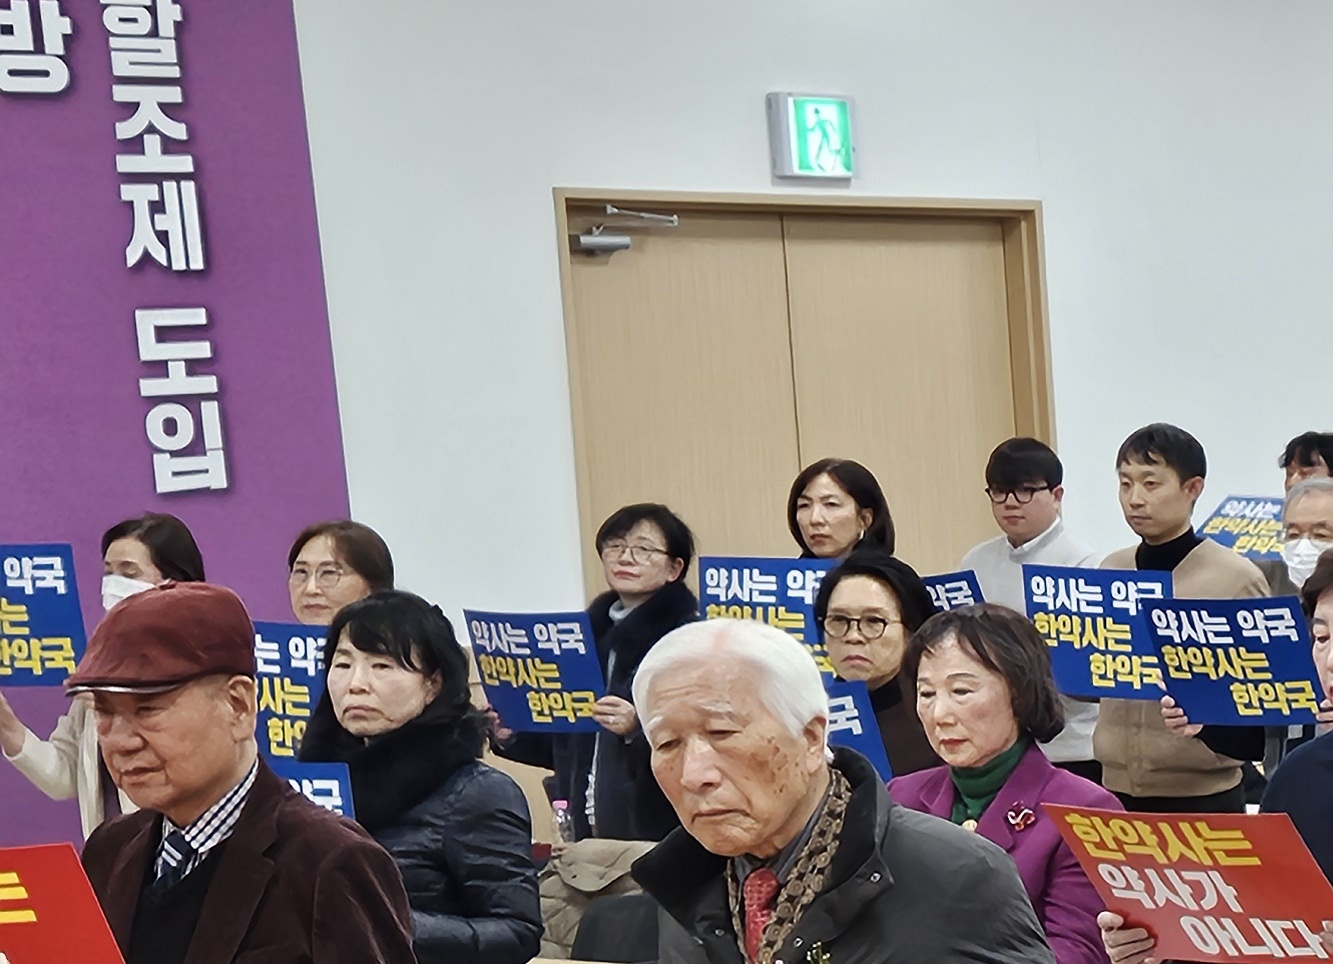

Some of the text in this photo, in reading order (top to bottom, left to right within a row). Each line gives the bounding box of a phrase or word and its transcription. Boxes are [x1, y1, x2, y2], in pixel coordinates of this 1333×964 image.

[134, 306, 229, 494] 도입
[3, 556, 66, 595] 약국
[704, 567, 828, 605] 약사는 약
[1030, 574, 1103, 614] 약사는
[471, 619, 587, 656] 약사는 약국
[1033, 611, 1133, 653] 한약사는
[1150, 606, 1300, 646] 약사는 약국
[288, 634, 329, 677] 약
[478, 654, 563, 690] 한약사는
[1160, 644, 1274, 681] 한약사는
[1228, 680, 1320, 717] 한약국
[1063, 811, 1263, 867] 한약사는
[1096, 862, 1245, 914] 약사가
